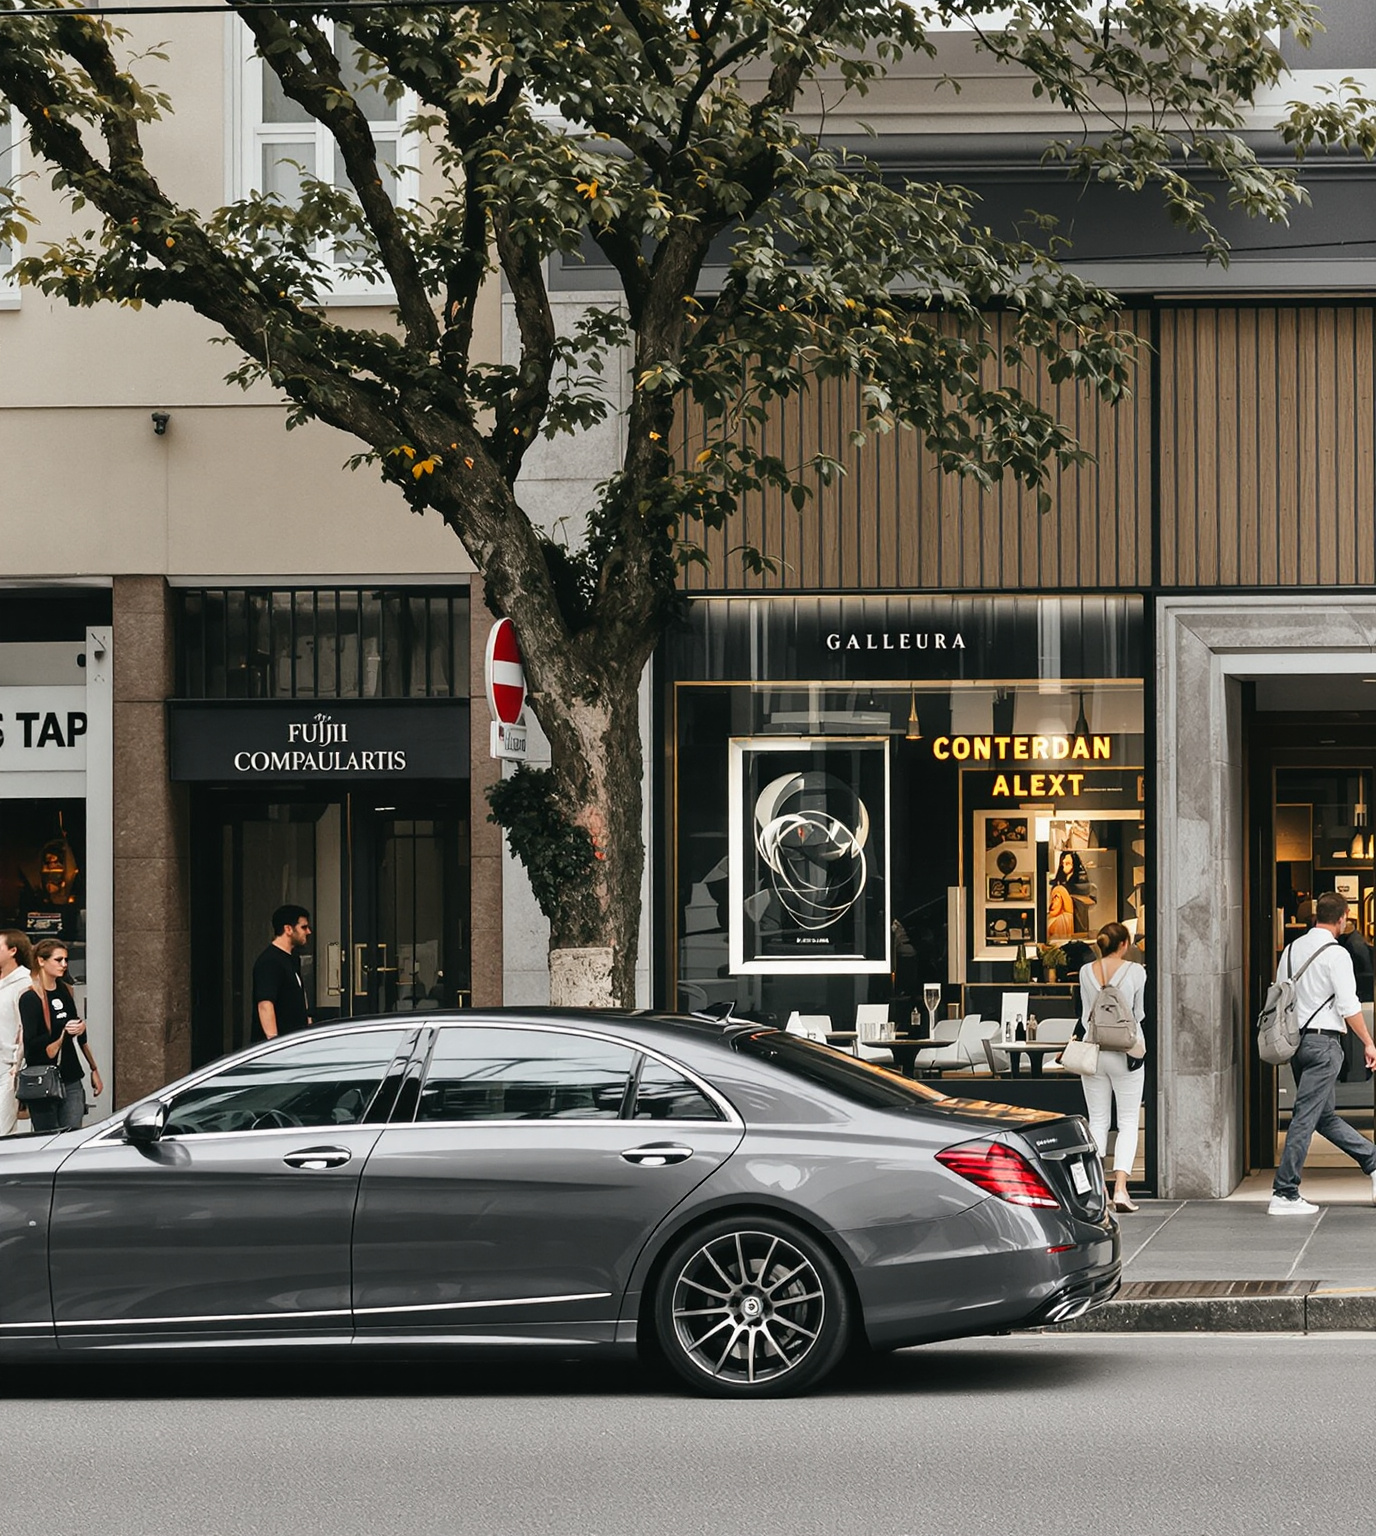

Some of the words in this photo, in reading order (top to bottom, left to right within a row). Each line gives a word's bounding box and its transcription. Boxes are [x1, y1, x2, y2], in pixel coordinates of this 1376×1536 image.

[826, 633, 966, 650] GALLEURA
[15, 712, 88, 748] TAP
[932, 735, 1111, 761] CONTERDAN
[233, 750, 407, 772] COMPAULARTIS
[992, 773, 1084, 797] ALEXT
